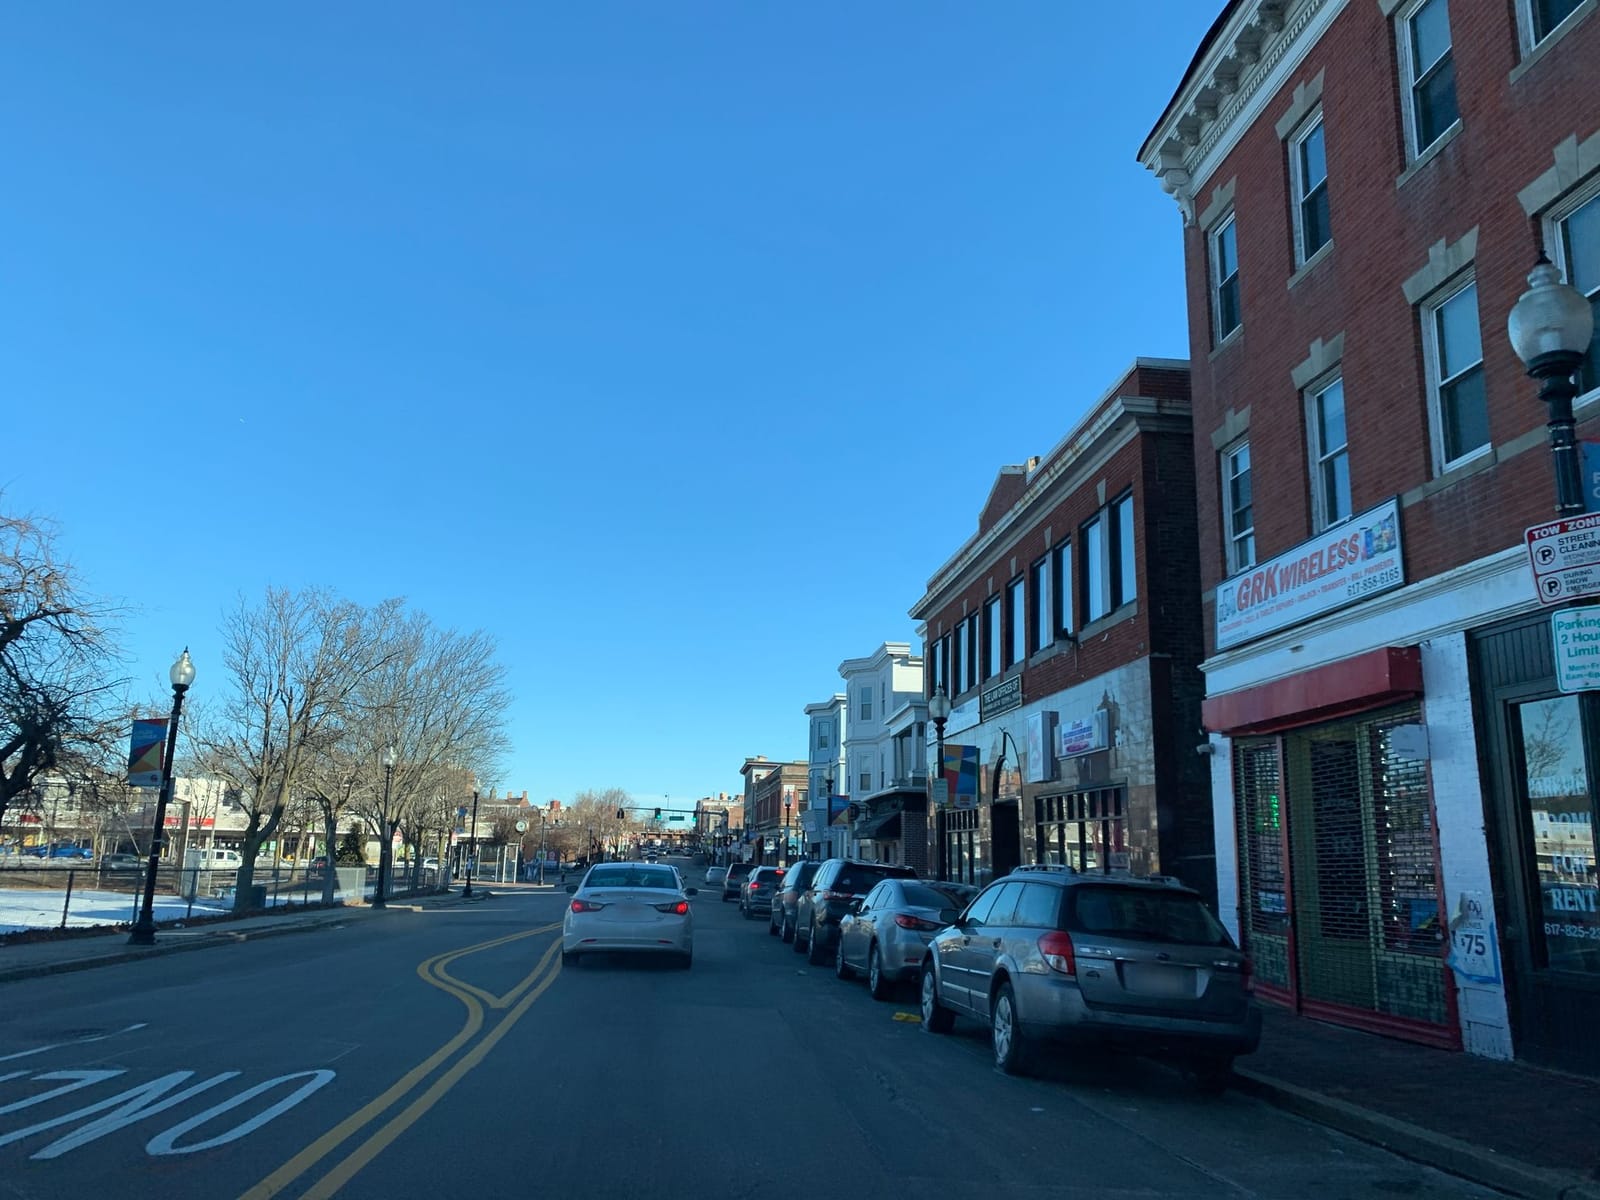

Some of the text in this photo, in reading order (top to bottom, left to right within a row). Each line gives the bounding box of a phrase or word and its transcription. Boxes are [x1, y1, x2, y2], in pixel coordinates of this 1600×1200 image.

[1532, 524, 1560, 540] TOW
[1557, 531, 1595, 546] STREET
[1237, 533, 1360, 612] GRK WIRELESS
[1563, 568, 1593, 579] DURING
[1565, 576, 1588, 586] SNOW
[1561, 631, 1600, 645] 2 Hou
[1567, 644, 1600, 658] Limit
[1551, 888, 1597, 912] RENT
[0, 1069, 337, 1160] ONL
